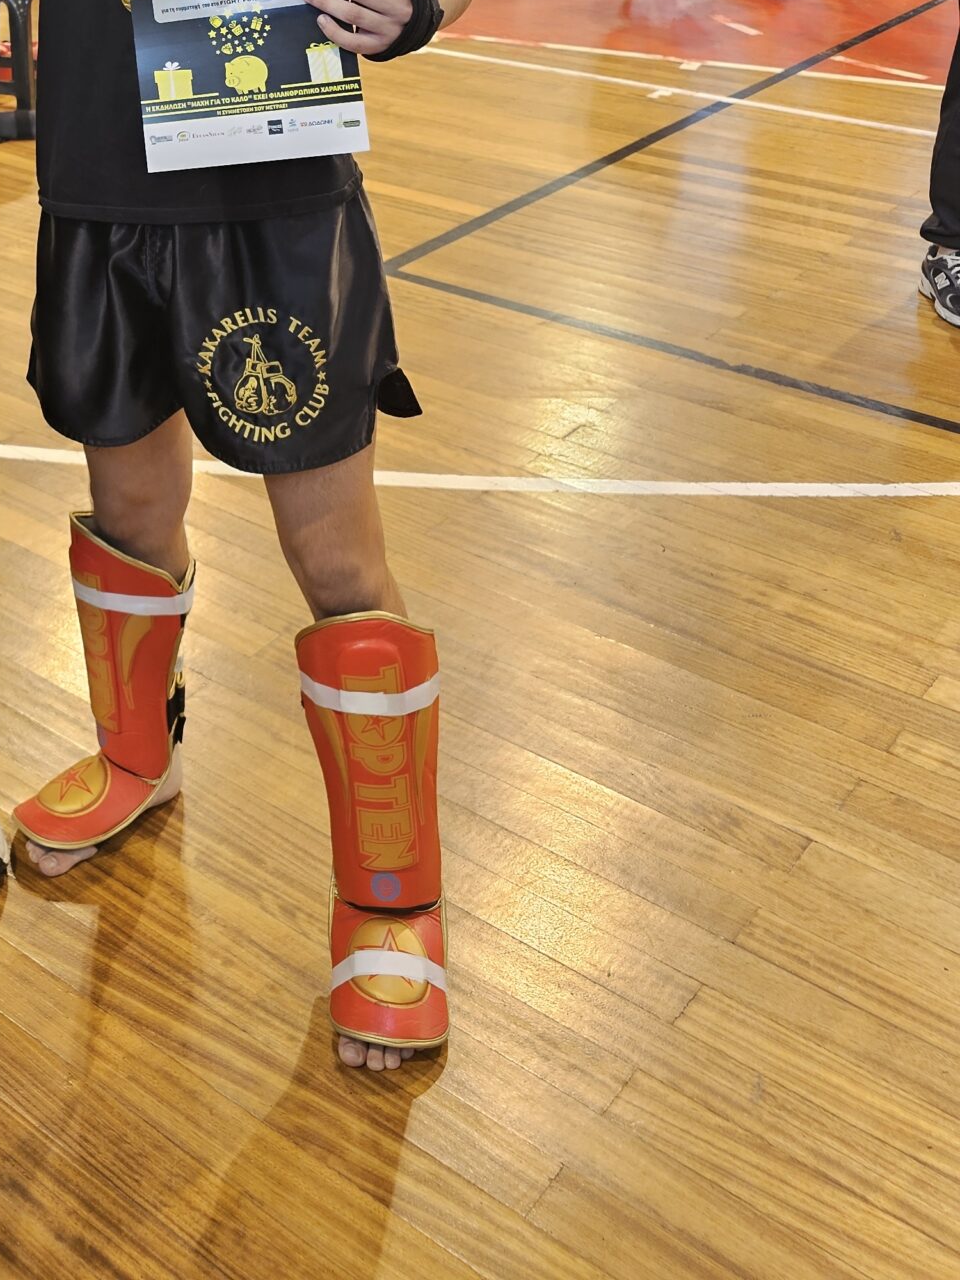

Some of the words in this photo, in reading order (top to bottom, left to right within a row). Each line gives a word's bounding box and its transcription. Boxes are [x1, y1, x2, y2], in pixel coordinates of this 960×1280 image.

[320, 83, 359, 93] ΧΑΡΑΚΤΗΡΑ
[196, 307, 278, 377] KAKARELIS
[288, 316, 327, 370] TEAM
[206, 391, 292, 443] FIGHTING
[294, 383, 330, 427] CLUB
[354, 773, 419, 872] TEN
